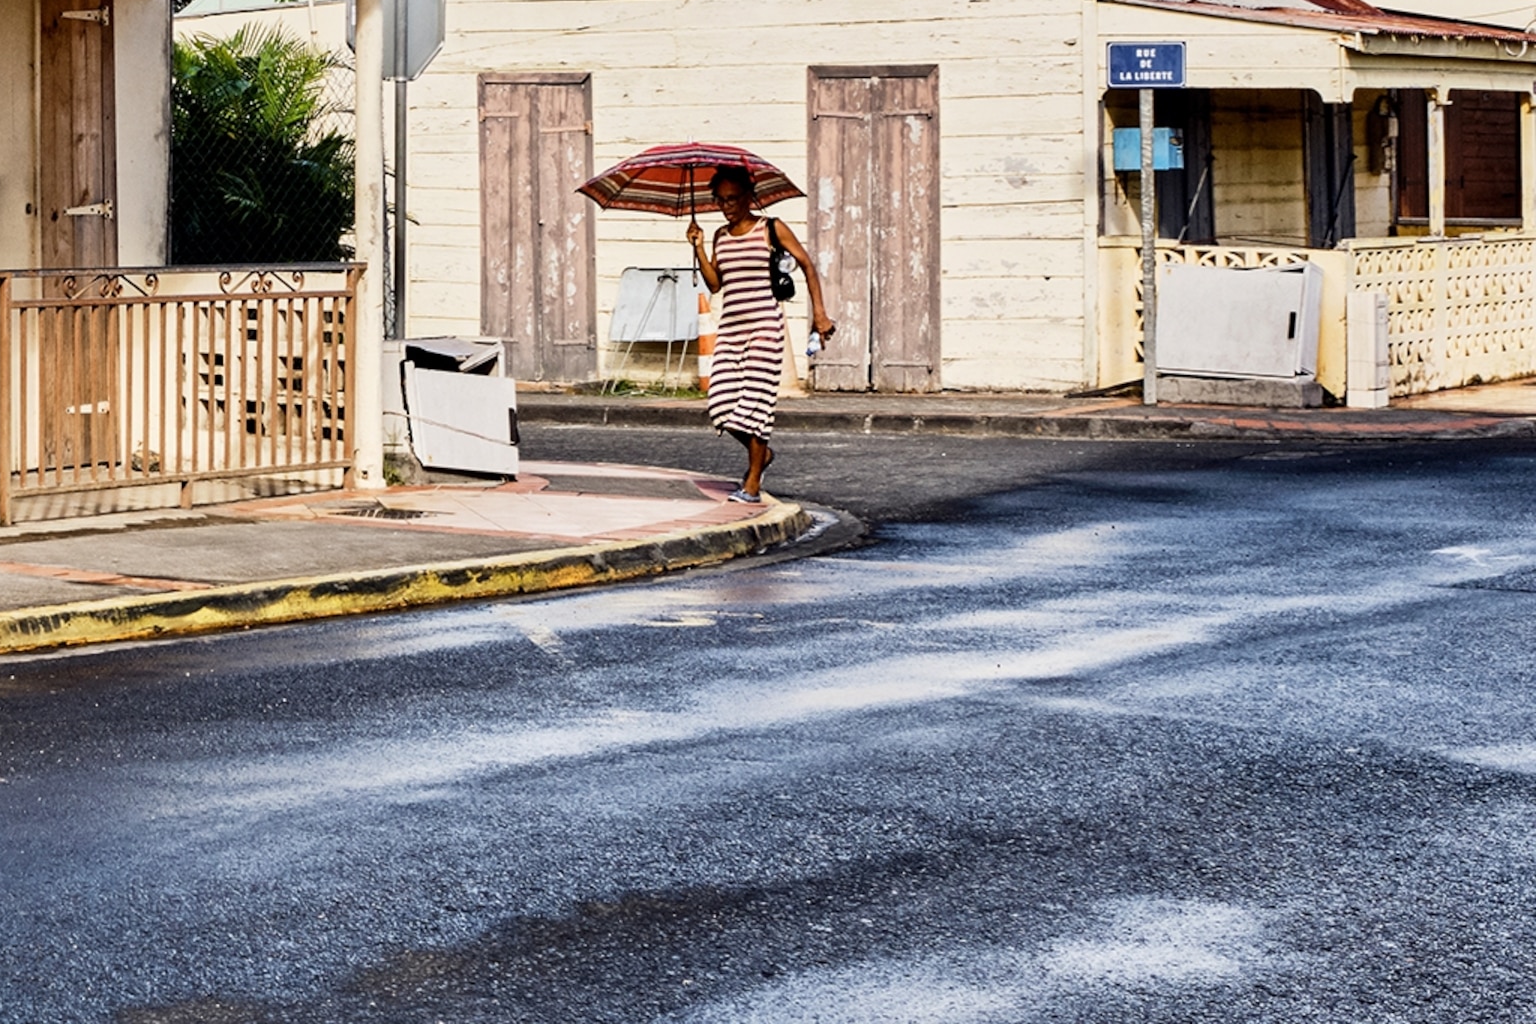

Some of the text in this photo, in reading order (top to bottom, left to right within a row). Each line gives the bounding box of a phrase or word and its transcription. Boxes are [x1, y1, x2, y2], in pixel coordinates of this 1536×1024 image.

[1136, 48, 1156, 58] RUE
[1139, 59, 1152, 69] DE
[1119, 71, 1173, 81] LA LIBERTE
